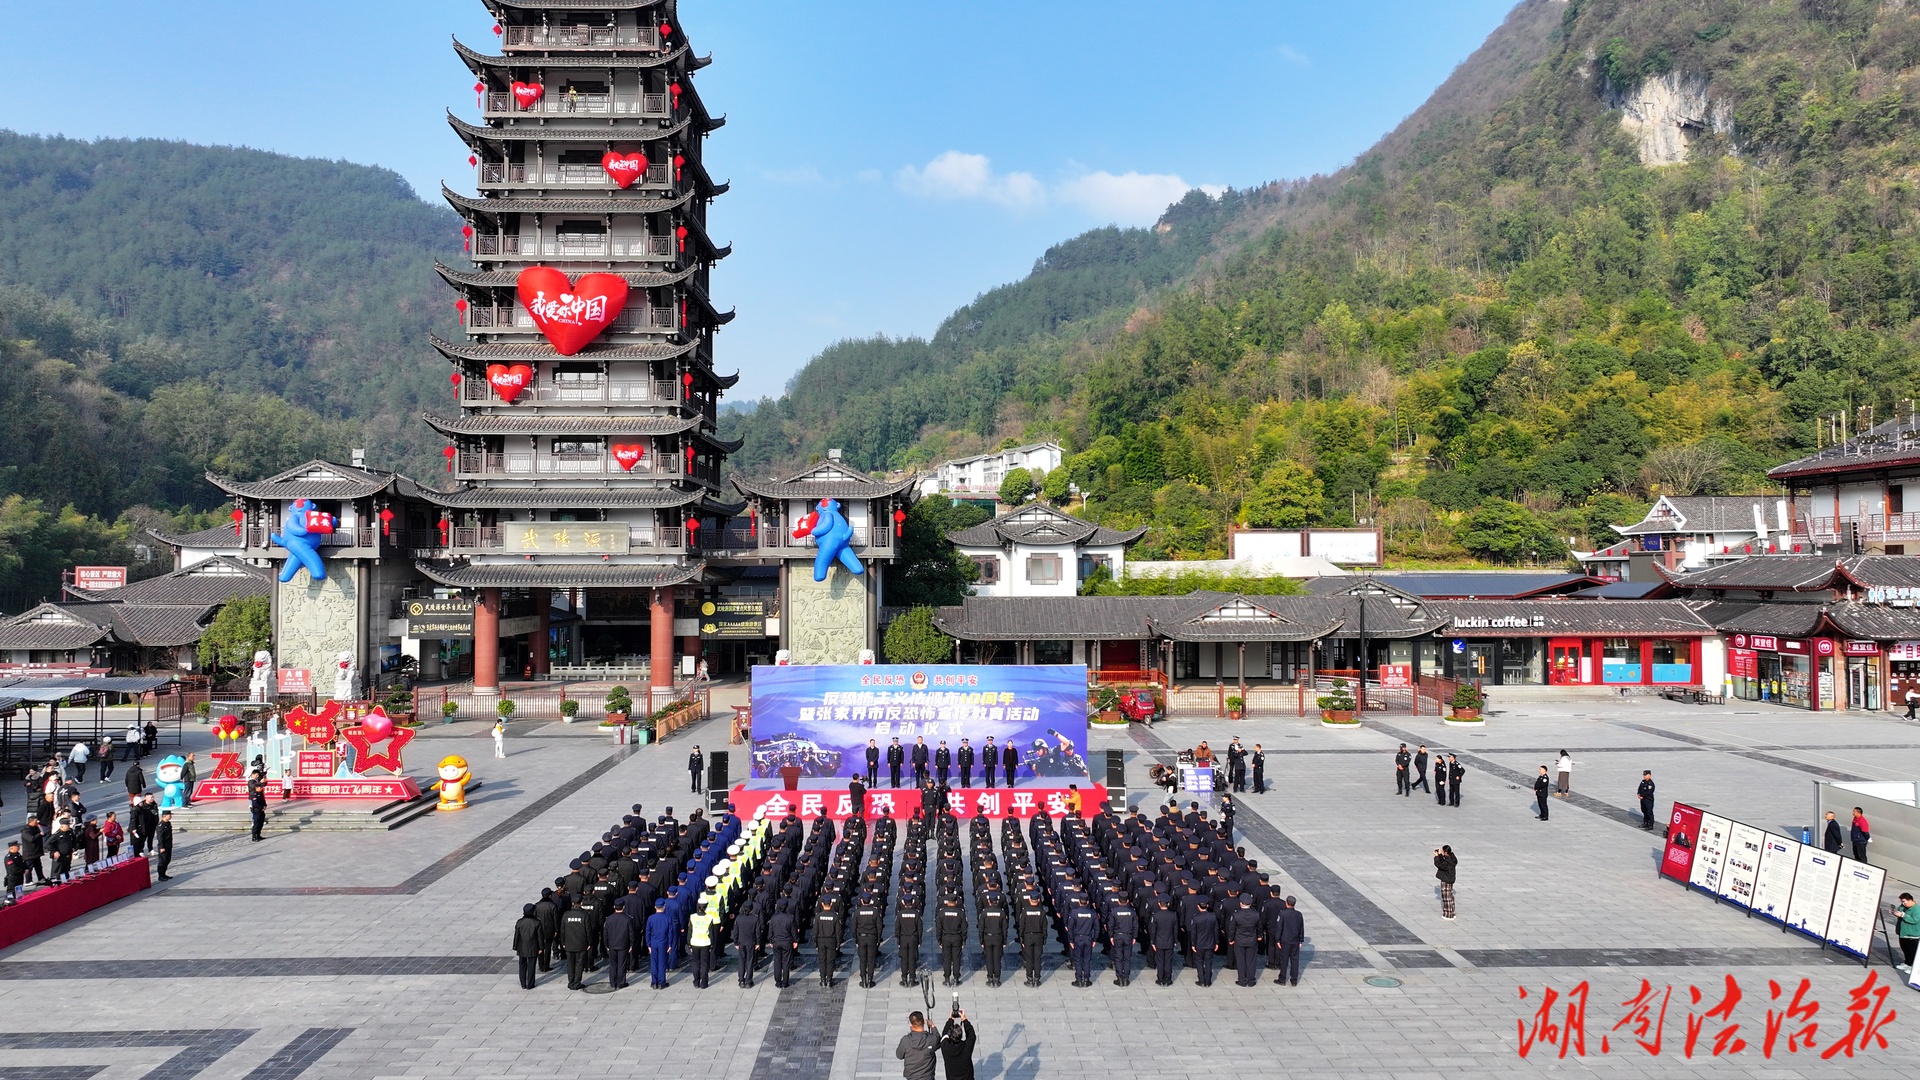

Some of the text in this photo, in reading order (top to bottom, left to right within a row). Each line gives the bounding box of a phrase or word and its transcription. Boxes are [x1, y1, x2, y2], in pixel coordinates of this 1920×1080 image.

[530, 290, 608, 324] 我爱你中国
[491, 373, 523, 386] 我爱你中国
[520, 528, 601, 549] 武陵源
[1454, 615, 1529, 628] luckin coffee
[1754, 638, 1772, 648] 美宜佳
[861, 675, 979, 686] 全民反恐 共创平安
[823, 691, 1015, 706] 反恐怖主义法颁布10周年
[798, 707, 1040, 721] 暨张家界市反恐怖宣传教育活动
[874, 721, 964, 736] 启动仪式
[209, 752, 245, 779] 76
[765, 792, 1070, 816] 全民反恐 共创平安
